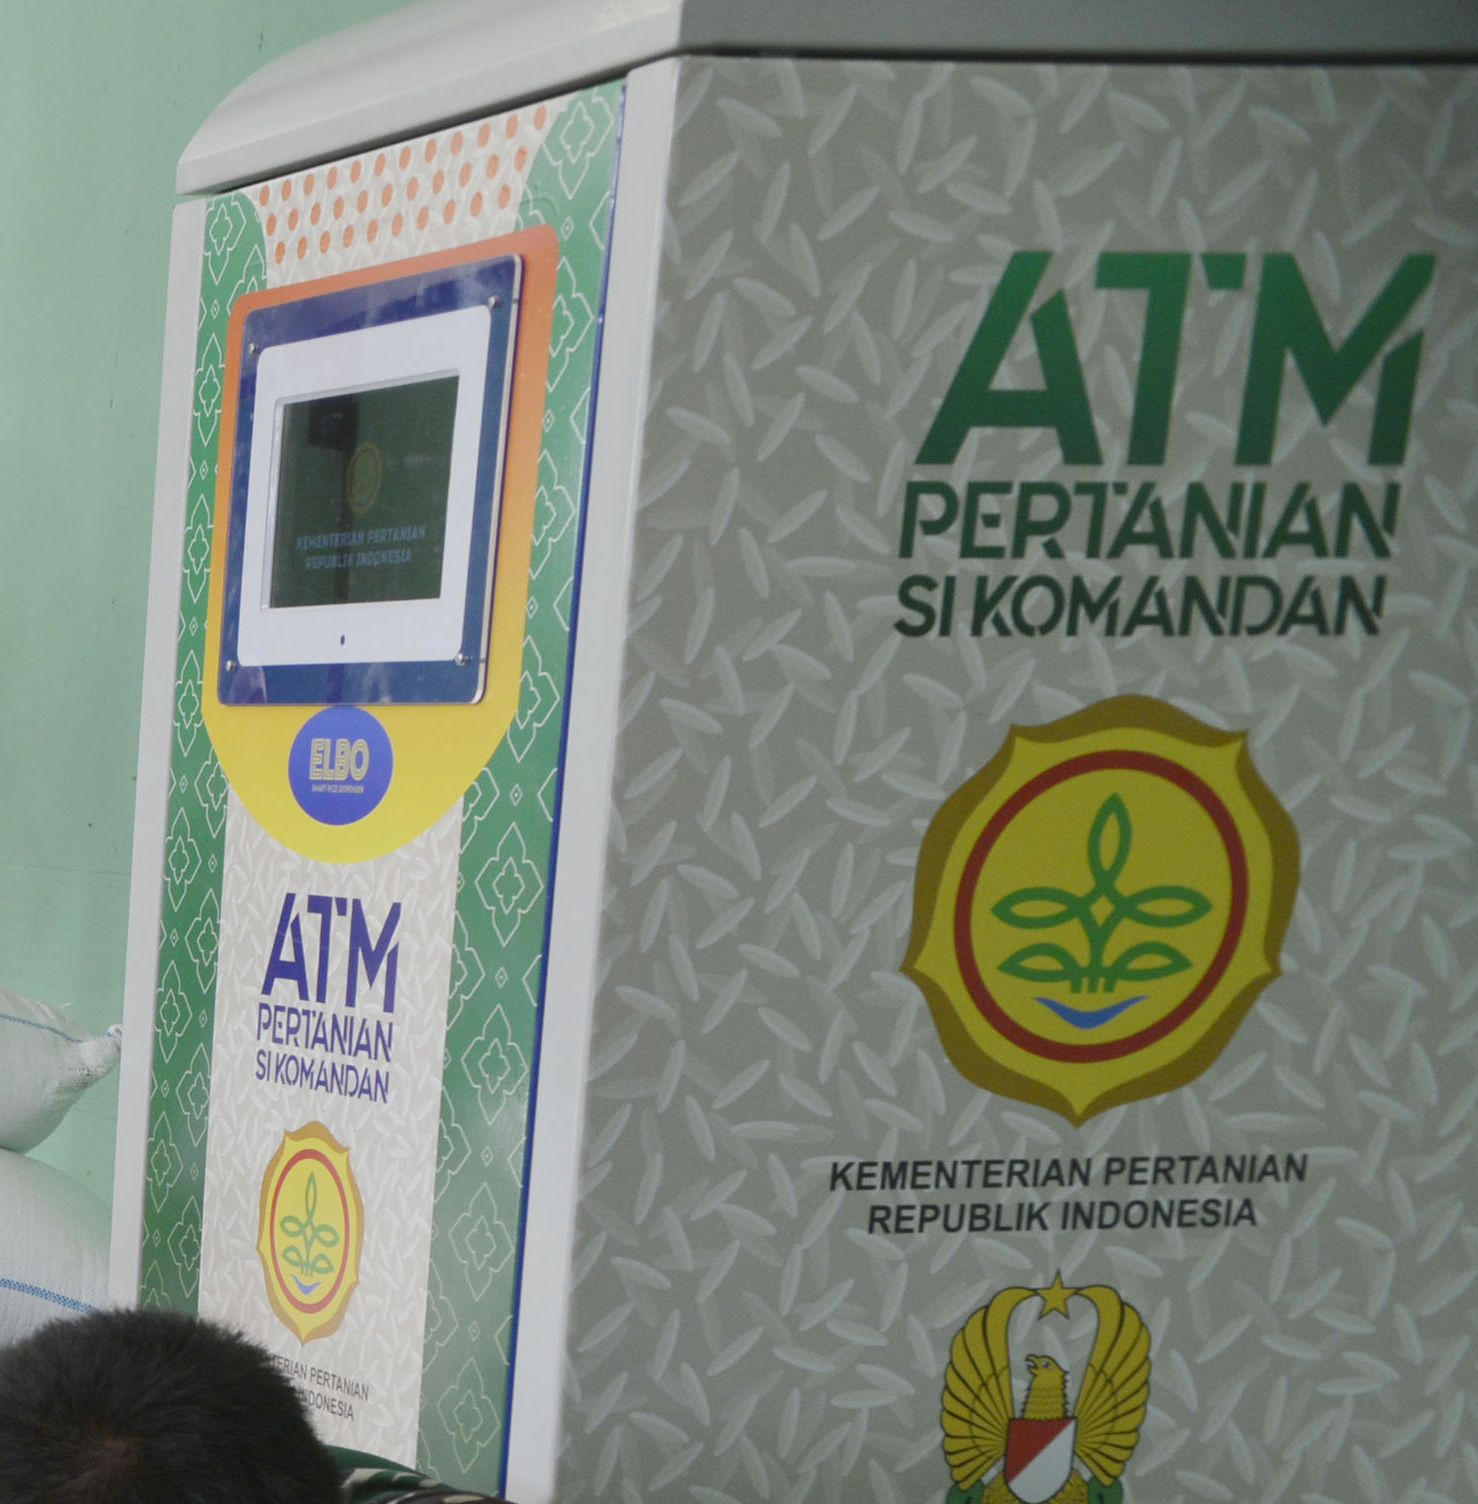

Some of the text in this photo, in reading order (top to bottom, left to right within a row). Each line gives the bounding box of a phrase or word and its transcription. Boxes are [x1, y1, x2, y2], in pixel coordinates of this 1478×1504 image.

[915, 251, 1436, 466] ATM
[296, 526, 426, 549] KEMENTERIAN PERTANIAN
[899, 481, 1401, 559] PERTANIAN
[306, 548, 412, 569] REPUBLIK INDONESIA
[893, 574, 1388, 638] SI KOMANDAN
[309, 737, 370, 781] ELBO
[261, 892, 401, 1013] ATM
[256, 1002, 393, 1063] PERTANIAN
[255, 1048, 390, 1104] SI KOMANDAN
[830, 1154, 1309, 1191] KEMENTERIAN PERTANIAN
[868, 1197, 1258, 1234] REPUBLIK INDONESIA
[270, 1355, 370, 1401] TERIAN PERTANIAN
[301, 1389, 355, 1421] NDONESIA
